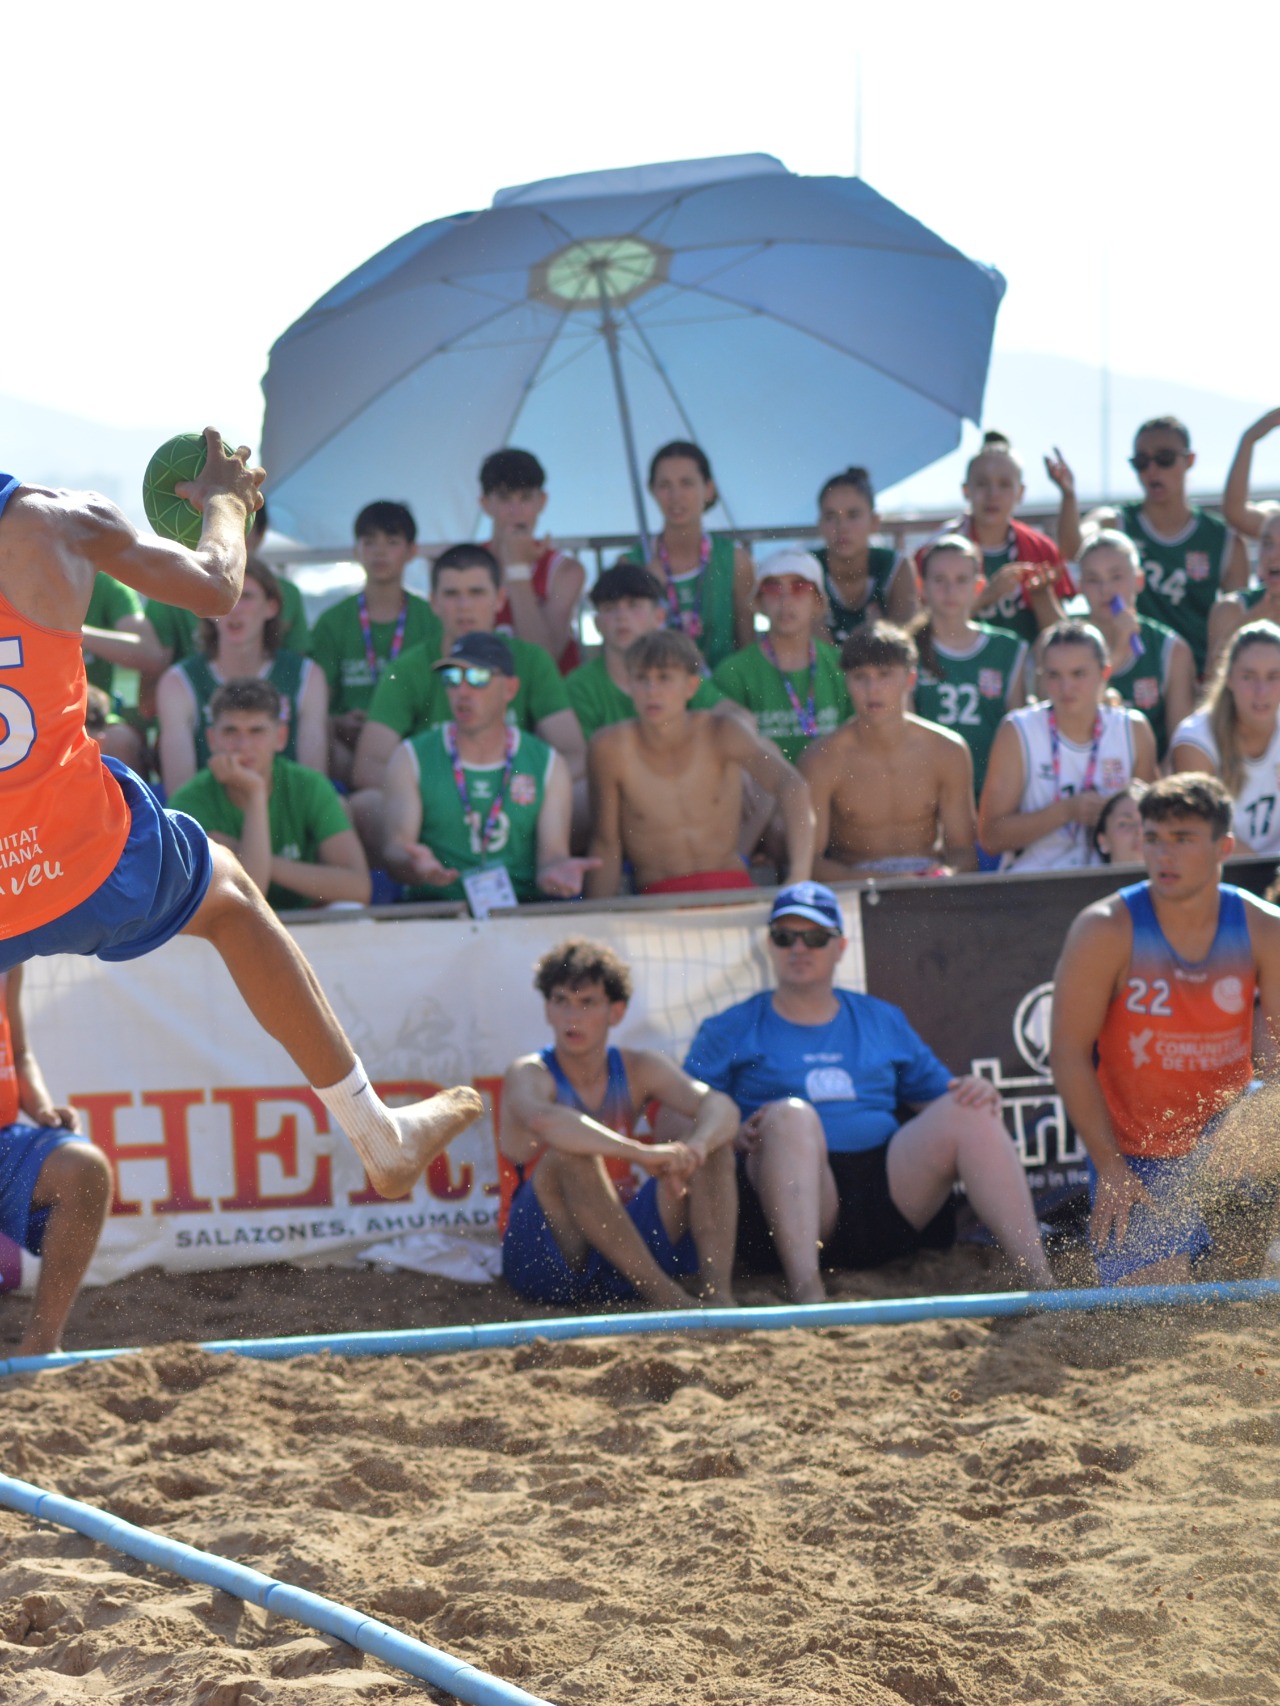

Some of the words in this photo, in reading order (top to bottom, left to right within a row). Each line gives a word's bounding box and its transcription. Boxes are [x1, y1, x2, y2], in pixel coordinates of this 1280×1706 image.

[936, 683, 981, 725] 32
[1245, 795, 1276, 838] 17
[11, 860, 64, 896] veu
[1126, 977, 1173, 1017] 22
[176, 1219, 355, 1248] SALAZONES,
